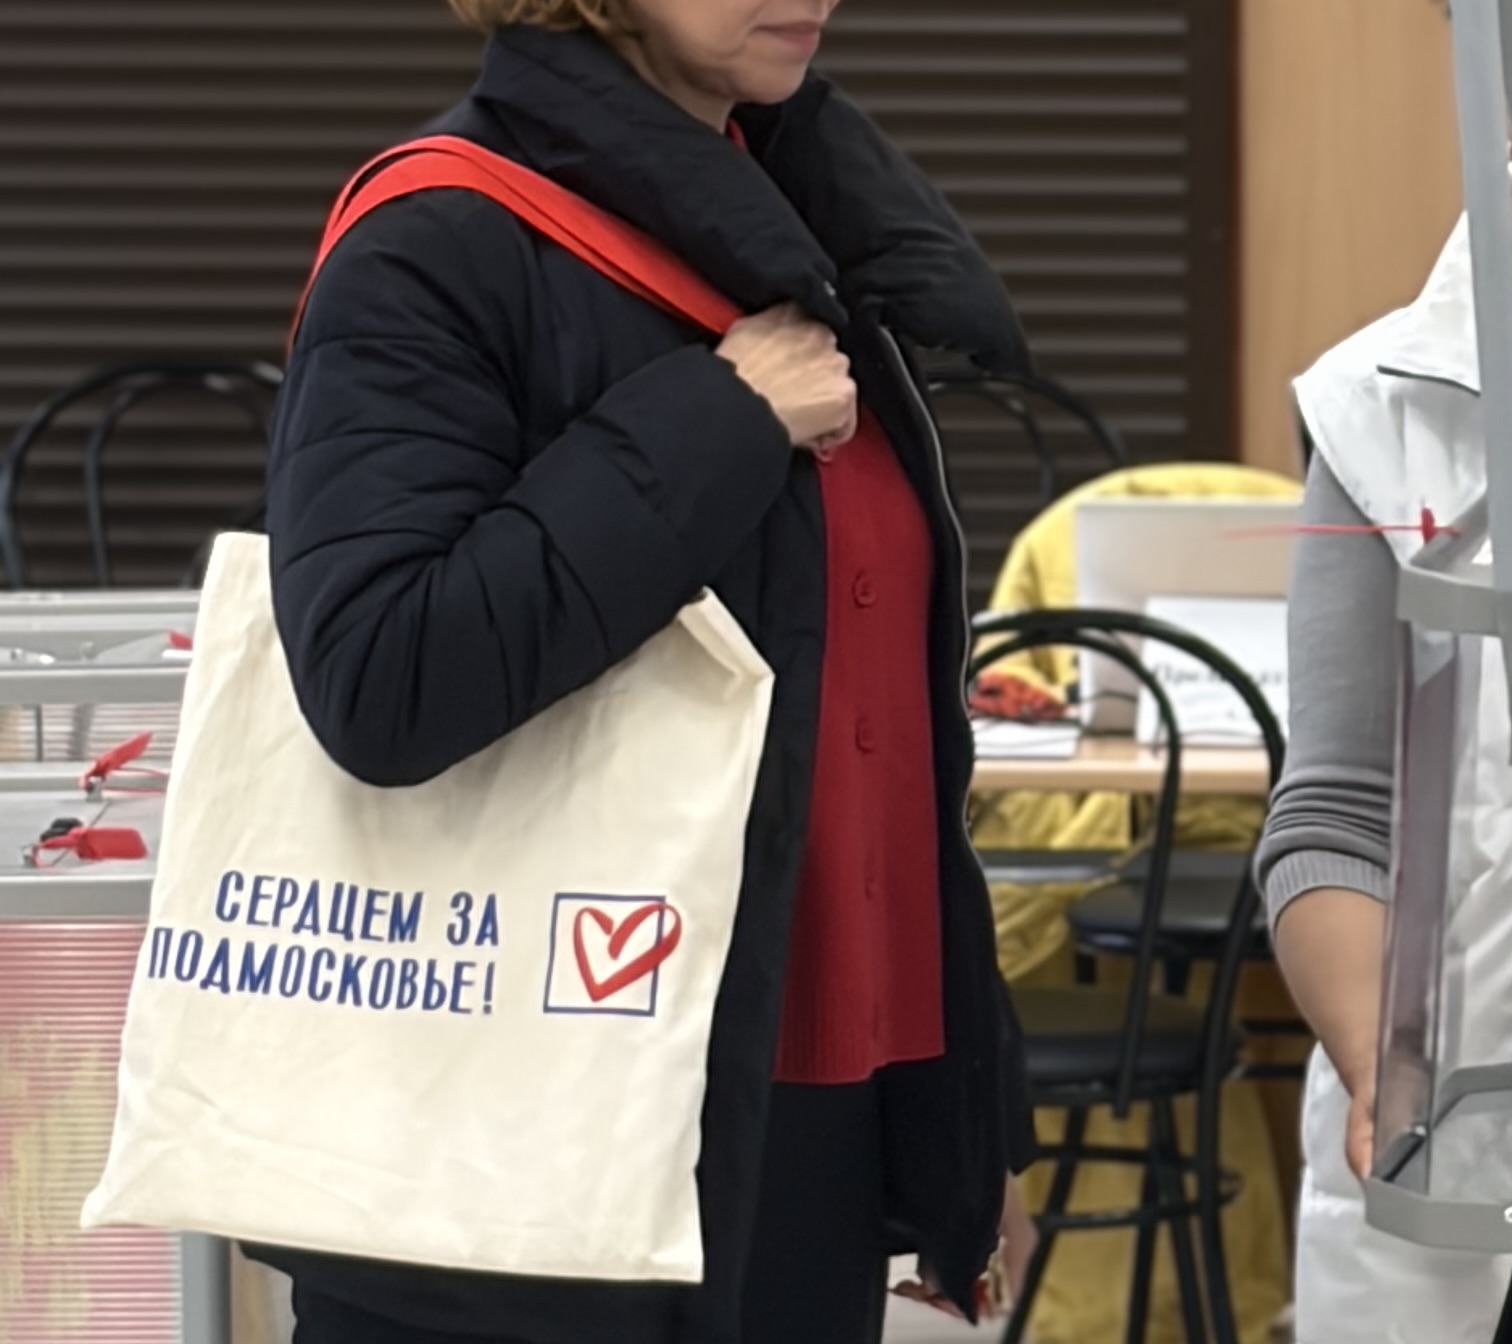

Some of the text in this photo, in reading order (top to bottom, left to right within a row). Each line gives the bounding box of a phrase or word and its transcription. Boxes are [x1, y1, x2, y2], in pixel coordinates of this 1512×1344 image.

[214, 870, 499, 946] СЕРДЦЕМ ЗА
[147, 926, 496, 1015] ПОДМОСКОВЬЕ!
